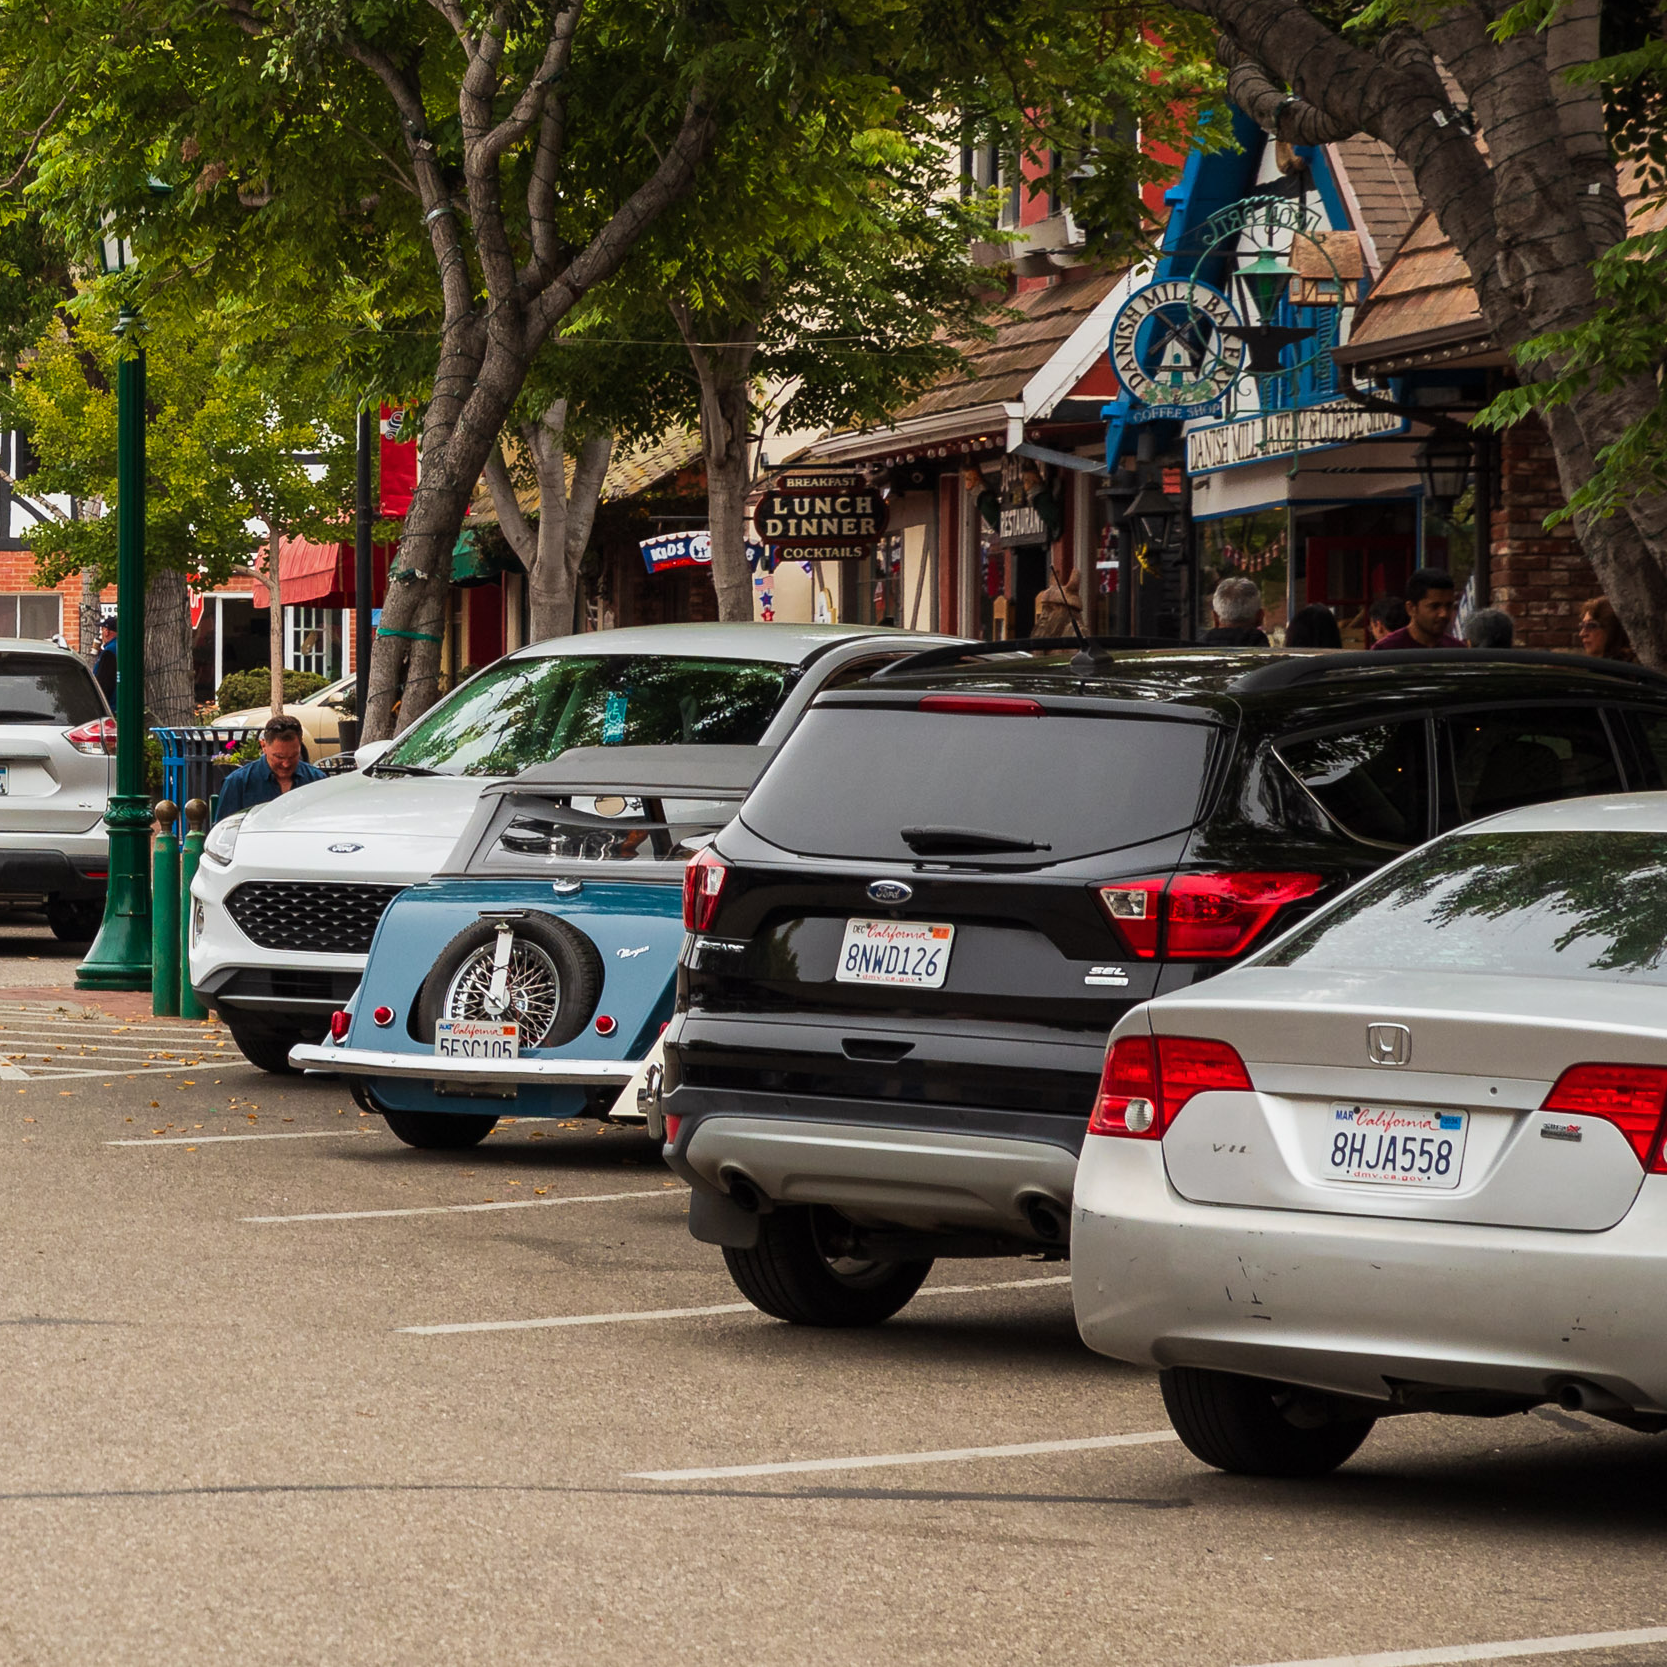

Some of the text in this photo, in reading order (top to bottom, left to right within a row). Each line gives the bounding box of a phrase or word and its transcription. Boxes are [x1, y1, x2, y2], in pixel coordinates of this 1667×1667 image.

[1115, 305, 1147, 389] DANISH
[1144, 283, 1198, 312] MILL
[1133, 403, 1222, 424] COFFEE SHOP
[1190, 426, 1230, 471] DANISH
[786, 477, 856, 488] BREAKFAST
[773, 496, 872, 515] LUNCH
[766, 517, 877, 537] DINNER
[650, 543, 686, 562] KIDS
[783, 546, 863, 559] COCKTAILS
[876, 884, 902, 899] Ford
[852, 924, 866, 934] DEC
[867, 923, 931, 943] California
[845, 943, 942, 977] 8NWD126
[862, 973, 916, 983] dmv.ca.gov
[1088, 966, 1126, 976] SEL
[452, 1022, 504, 1038] California
[1335, 1109, 1354, 1121] MAR
[1356, 1108, 1441, 1132] California
[1330, 1131, 1453, 1176] 8HJA558
[1353, 1172, 1424, 1182] dmv.ca.gov
